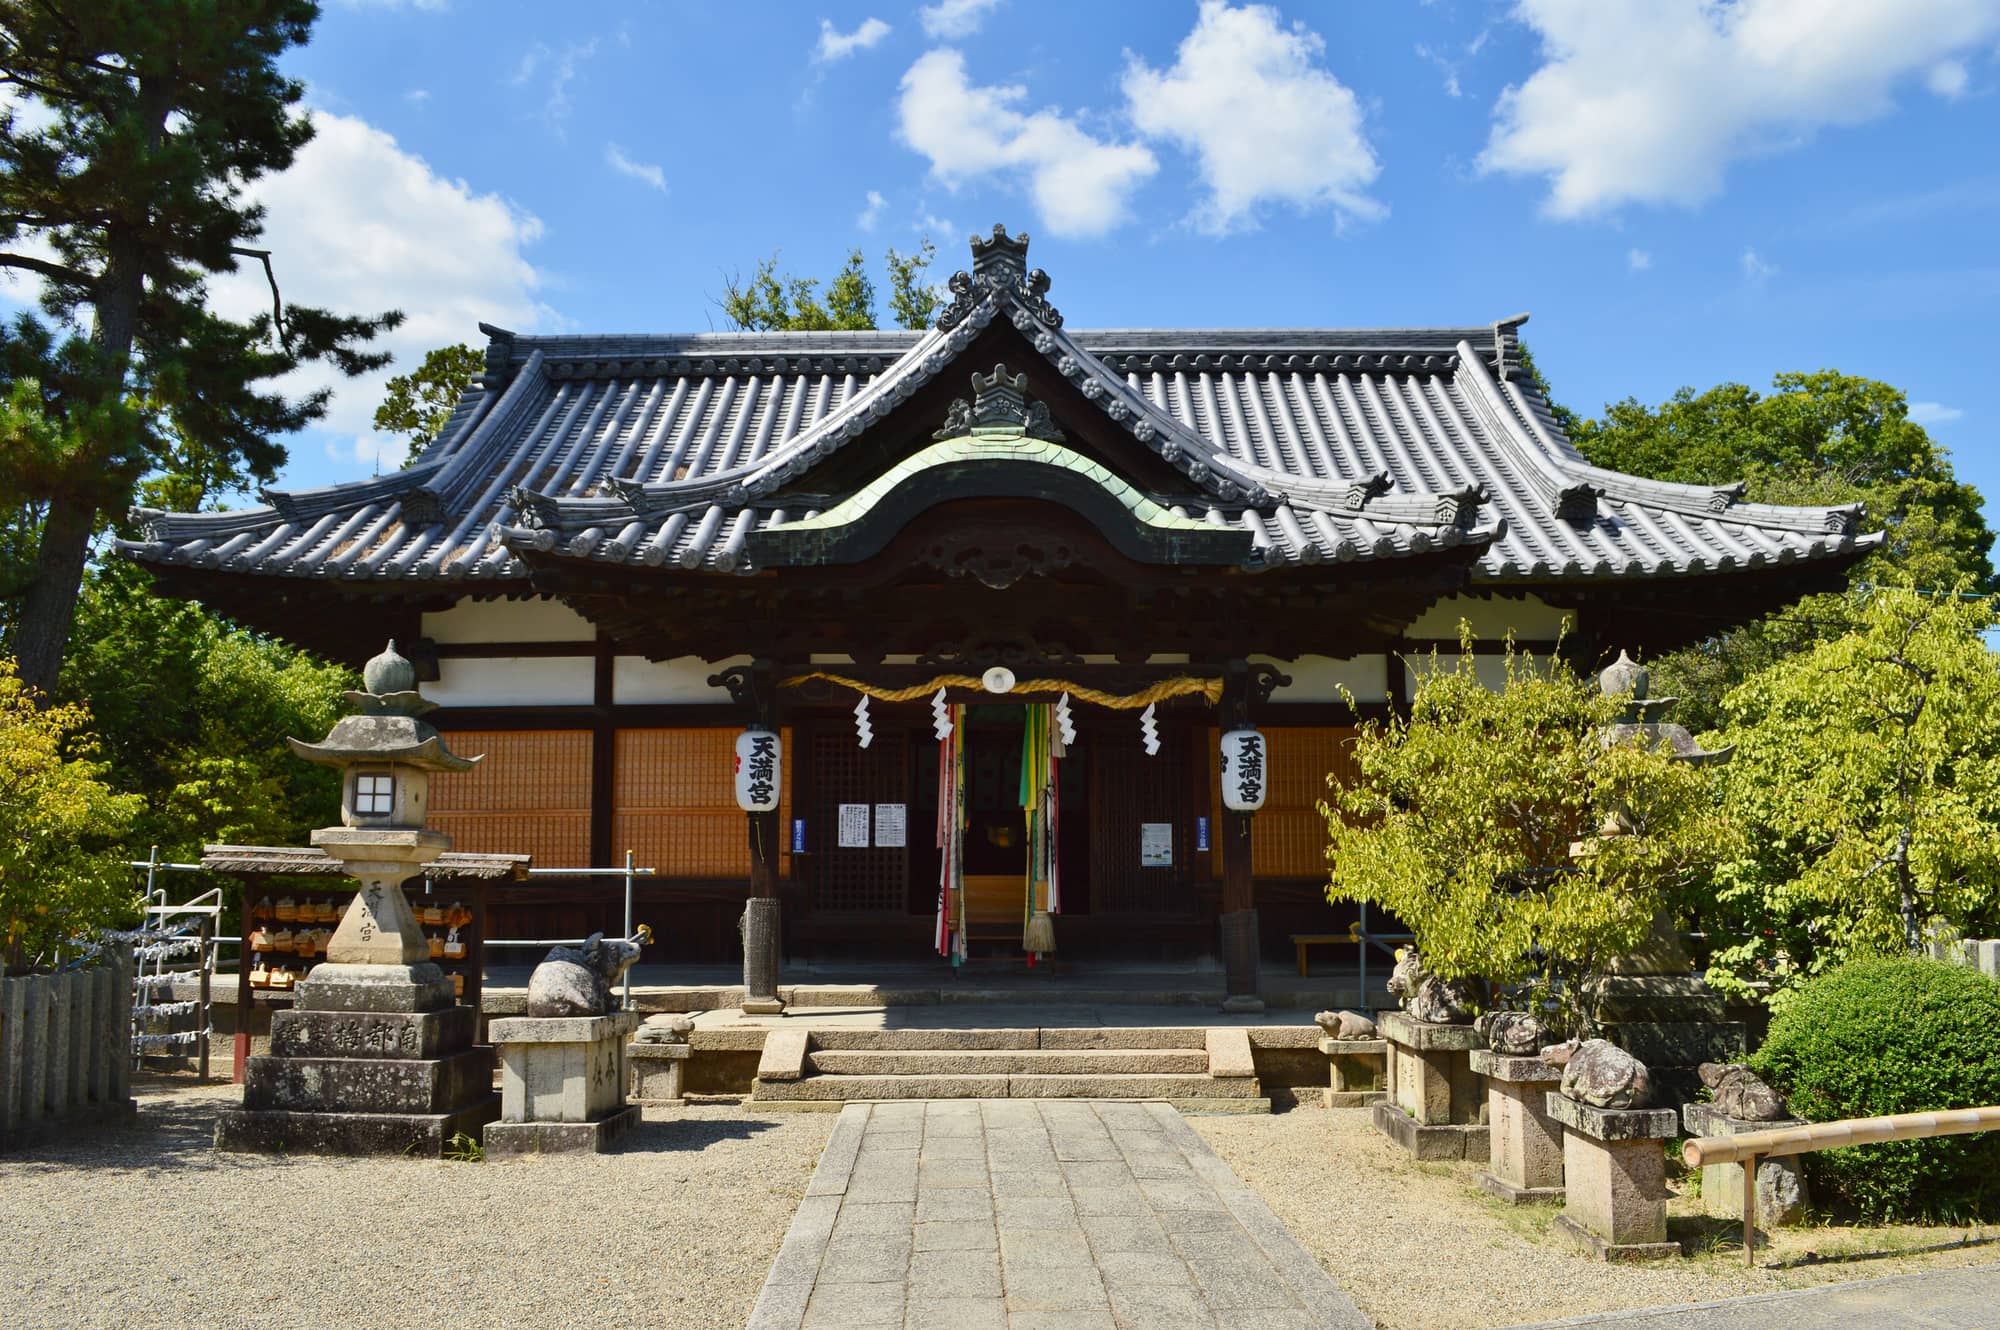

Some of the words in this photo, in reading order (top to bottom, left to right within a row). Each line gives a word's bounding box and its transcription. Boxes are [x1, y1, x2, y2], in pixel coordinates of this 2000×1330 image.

[748, 736, 776, 805] 天満宮
[1237, 736, 1264, 803] 天満宮
